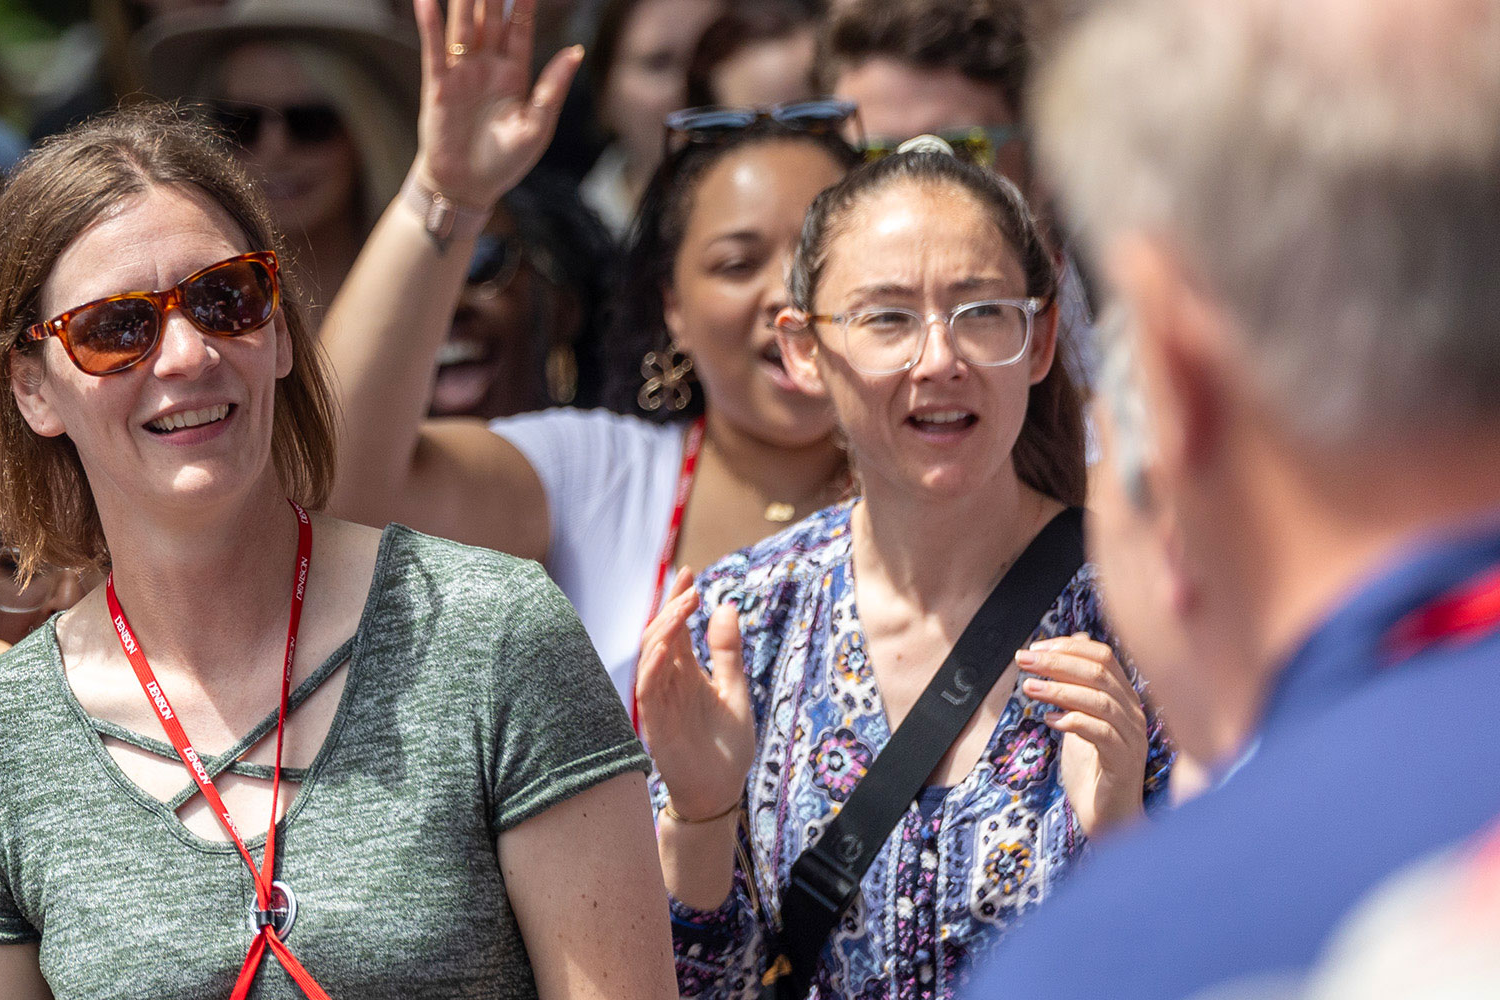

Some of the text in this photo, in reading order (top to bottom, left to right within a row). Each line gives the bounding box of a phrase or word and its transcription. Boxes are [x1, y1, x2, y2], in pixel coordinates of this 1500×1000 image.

[296, 556, 309, 601] DENISON
[114, 615, 138, 655] DENISON
[146, 680, 174, 721] DENISON
[183, 746, 212, 785] DENISON
